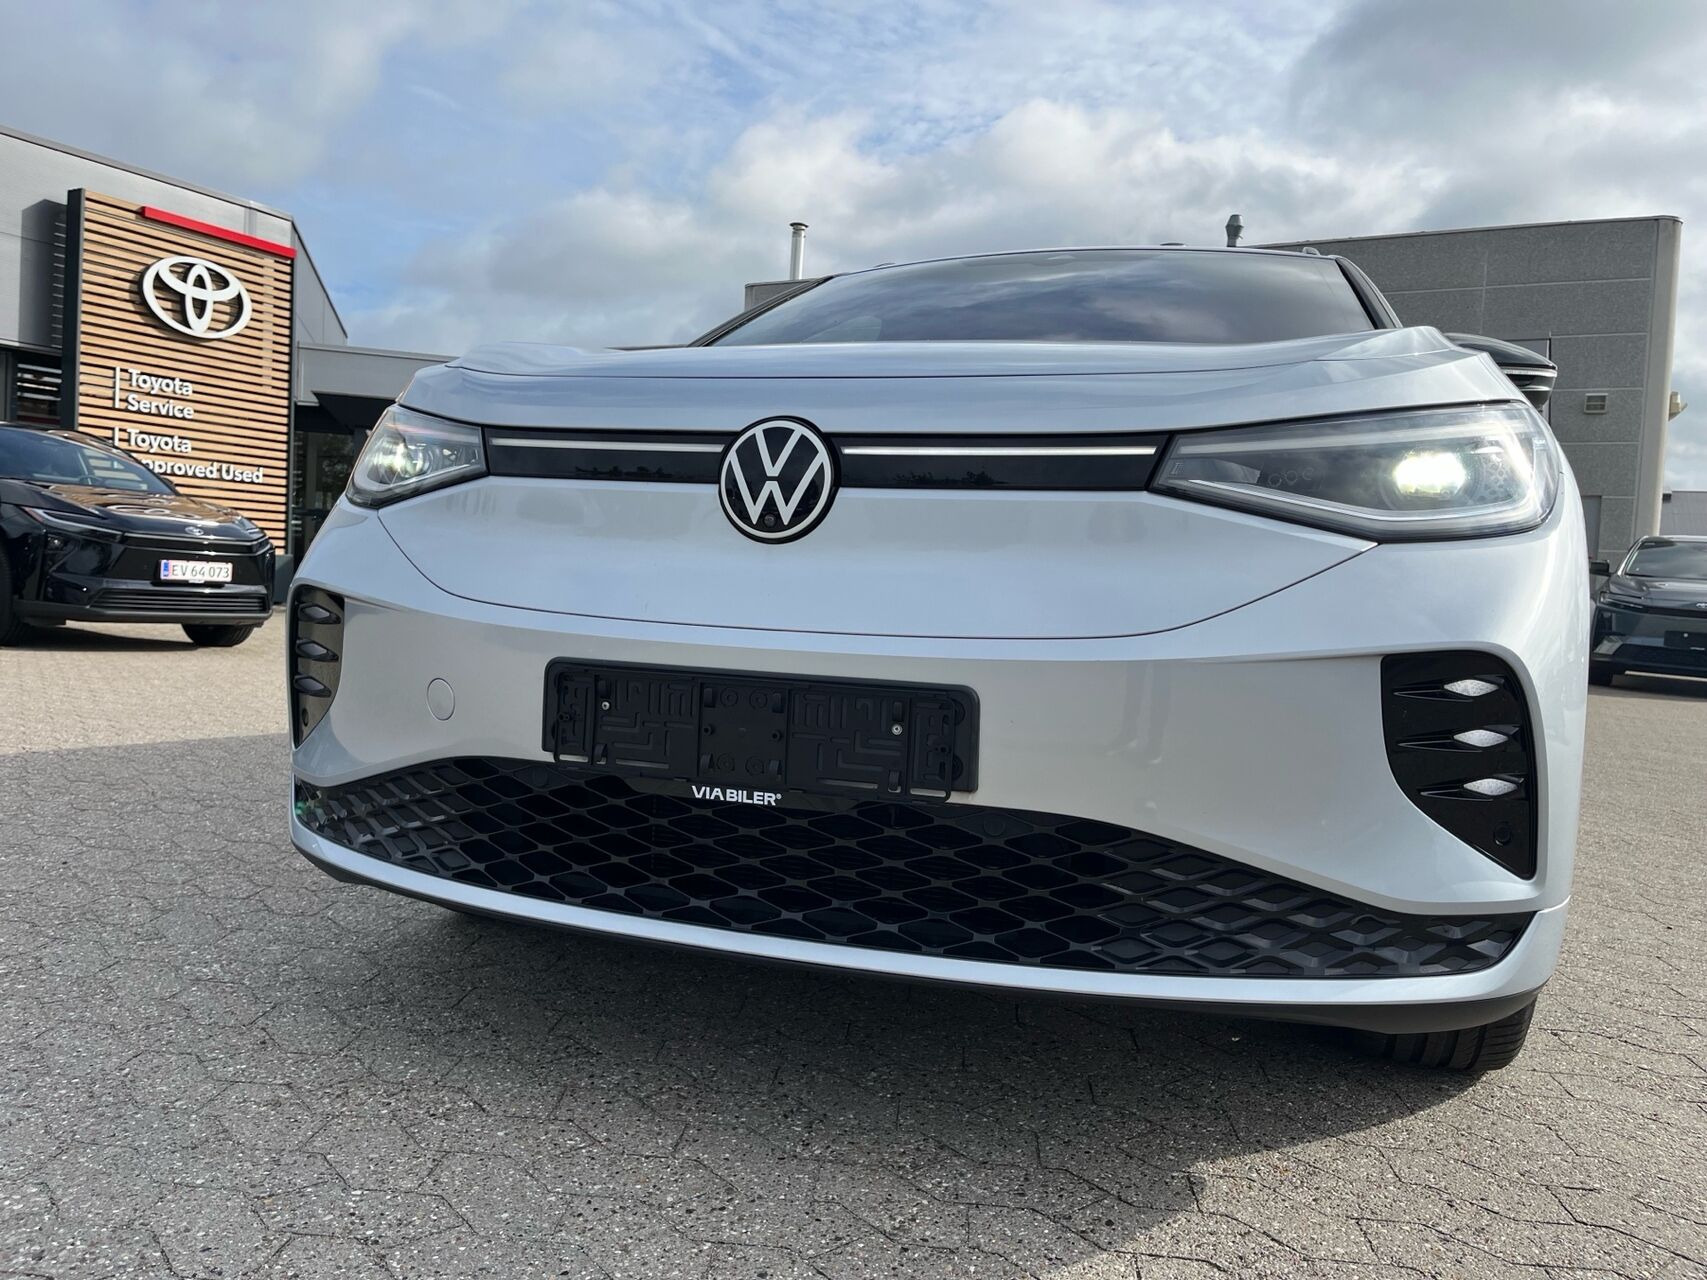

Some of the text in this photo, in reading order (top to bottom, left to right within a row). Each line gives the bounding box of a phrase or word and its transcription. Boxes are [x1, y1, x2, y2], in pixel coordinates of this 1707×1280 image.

[128, 368, 193, 396] Toyota
[127, 394, 195, 419] Service
[127, 428, 192, 453] Toyota
[221, 464, 264, 483] Used
[172, 564, 188, 577] EV
[191, 565, 206, 577] 64
[208, 566, 230, 579] 073
